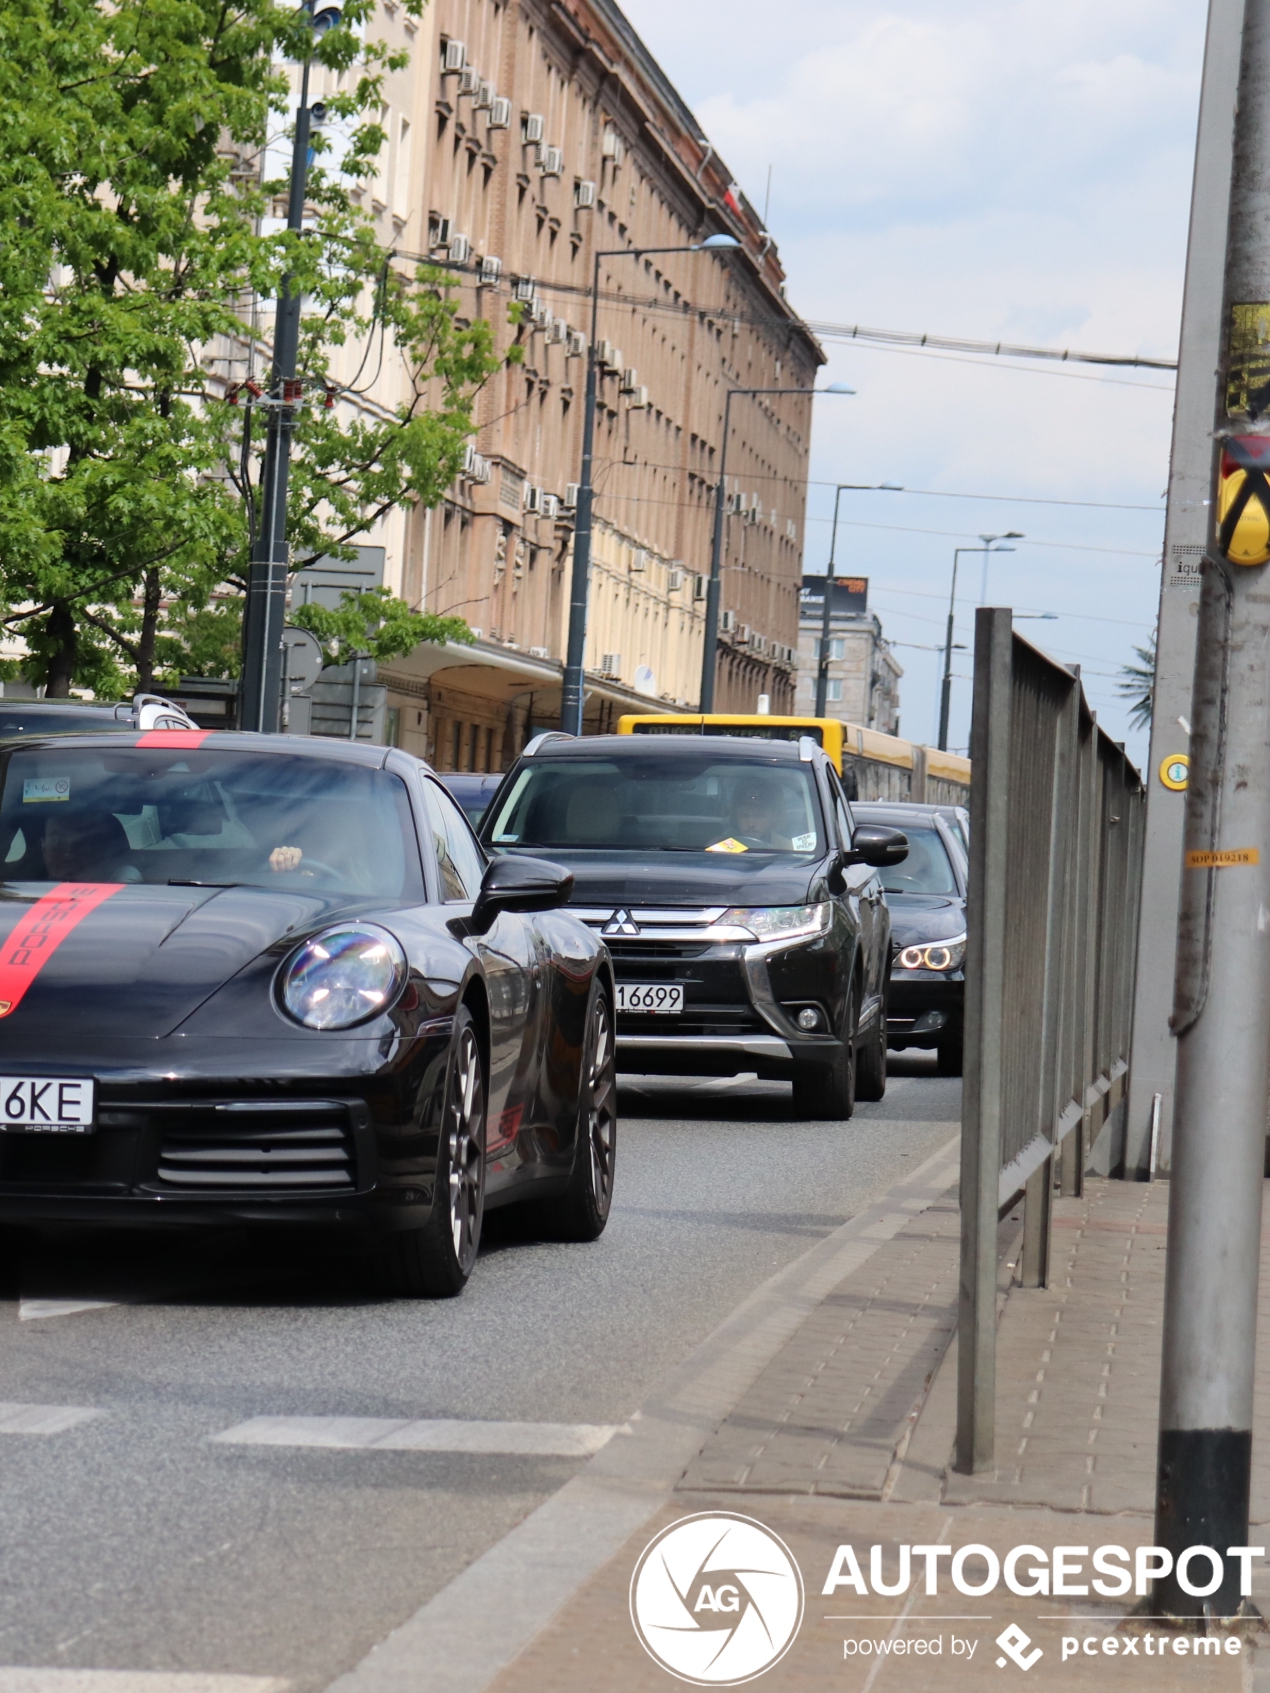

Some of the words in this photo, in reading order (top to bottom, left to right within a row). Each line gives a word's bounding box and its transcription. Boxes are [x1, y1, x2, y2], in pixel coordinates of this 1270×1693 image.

[1191, 855, 1210, 864] SOP
[618, 986, 681, 1008] 16699
[25, 1125, 85, 1133] PORSCHE
